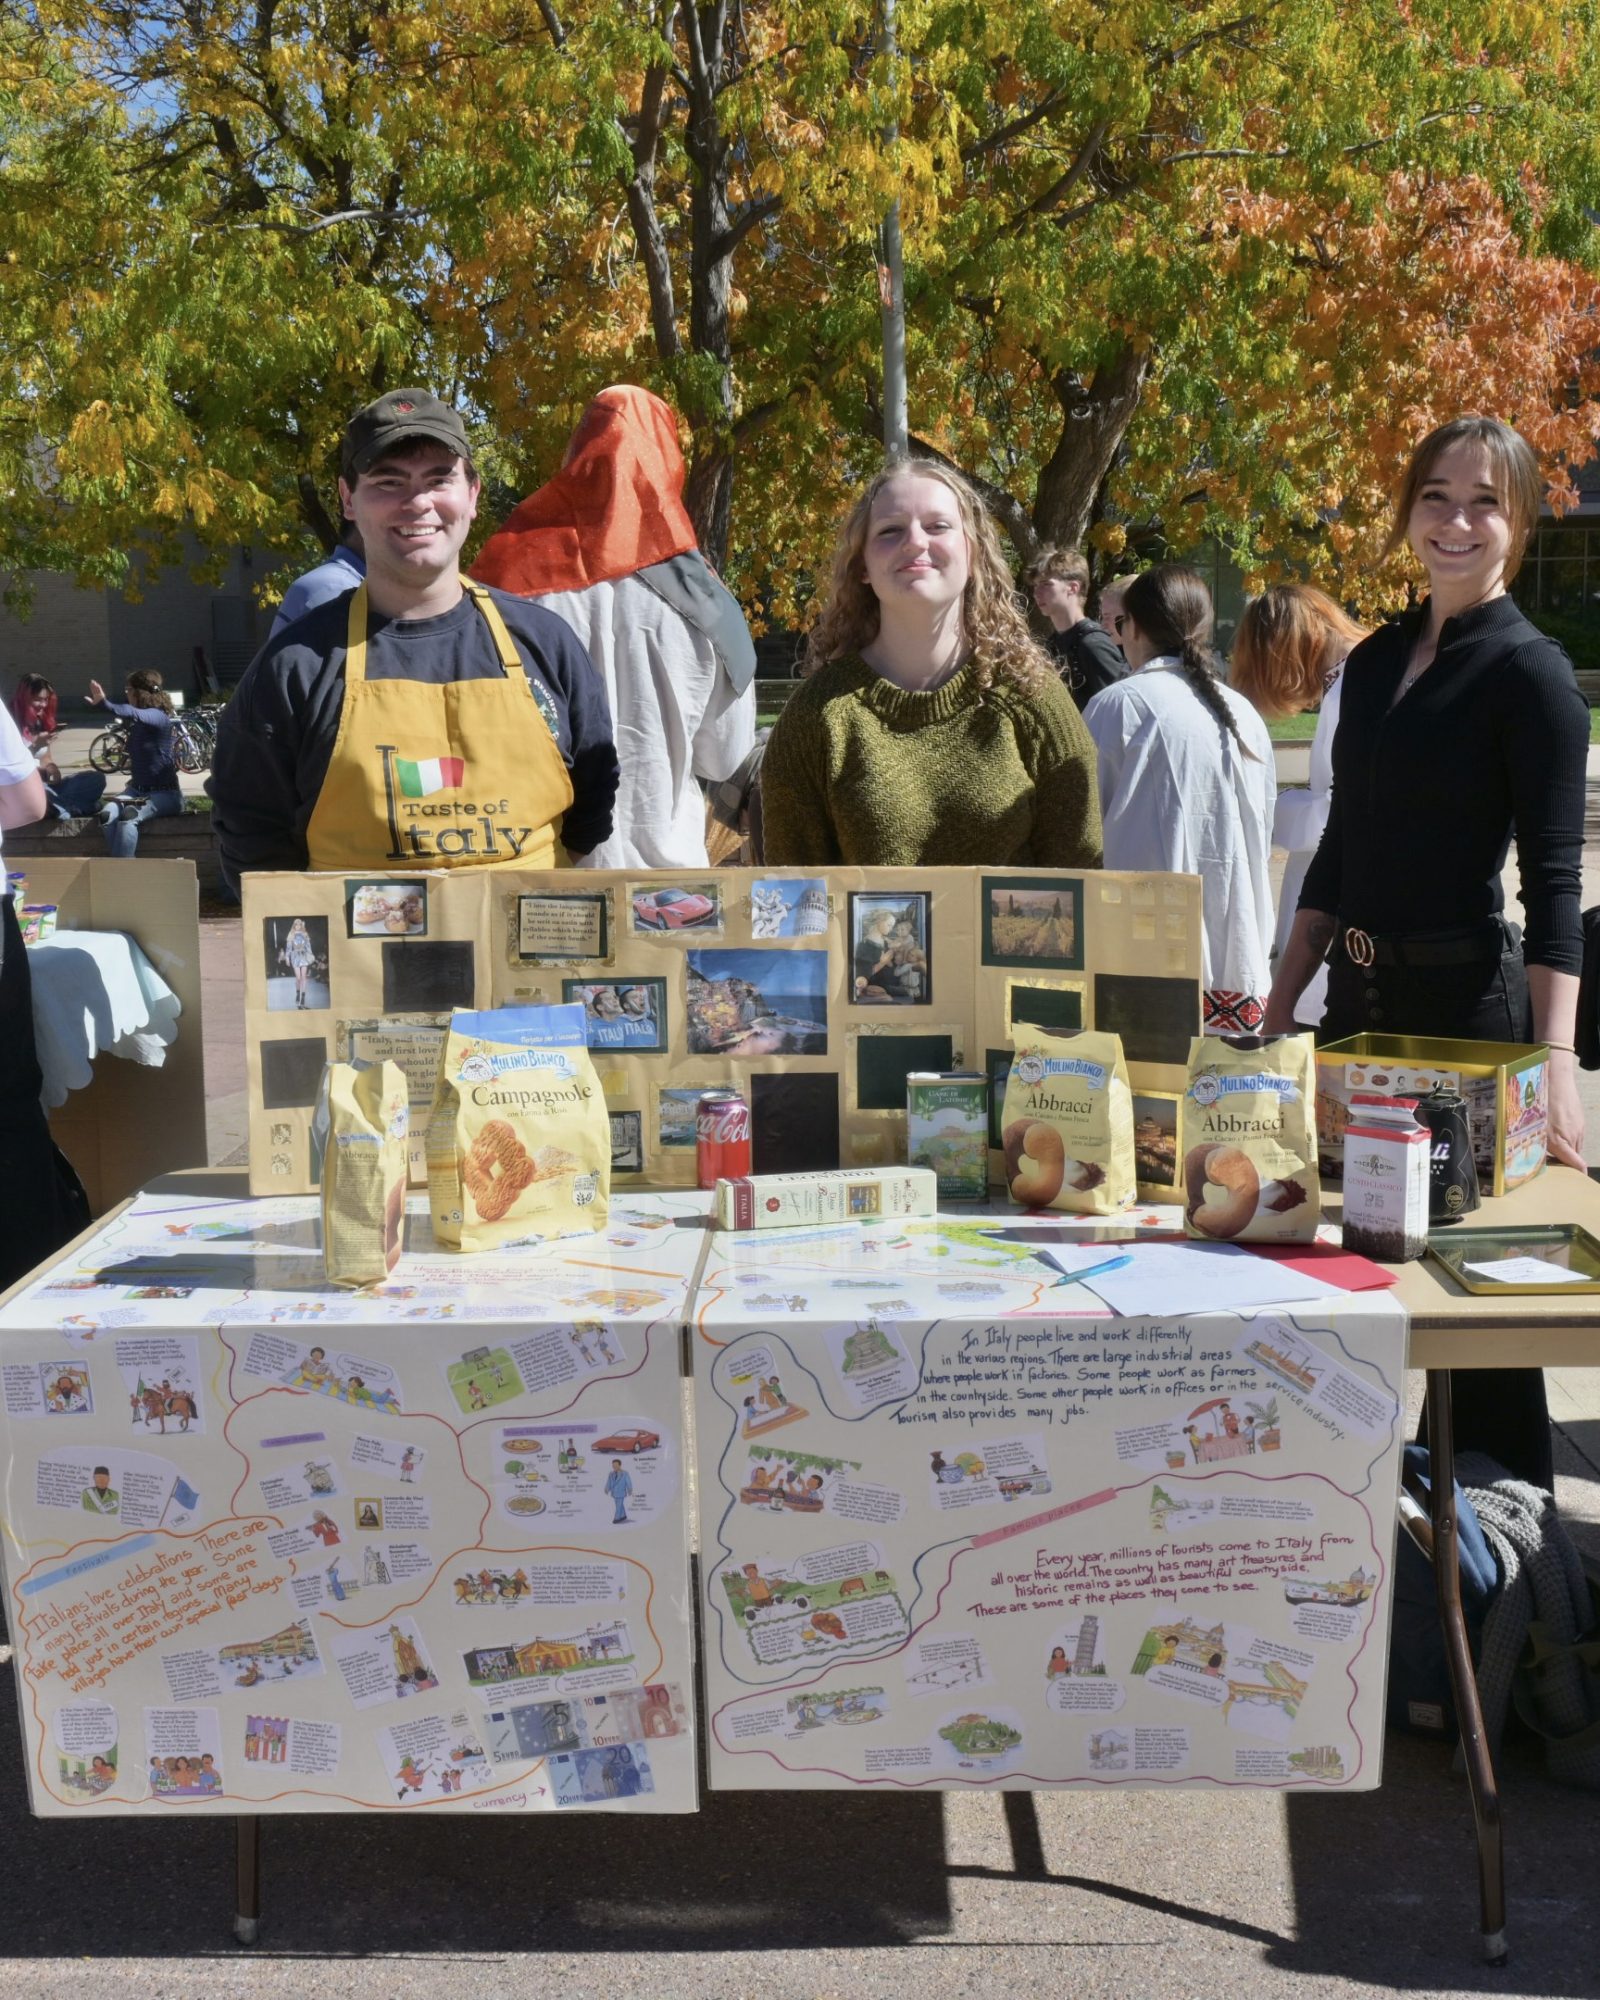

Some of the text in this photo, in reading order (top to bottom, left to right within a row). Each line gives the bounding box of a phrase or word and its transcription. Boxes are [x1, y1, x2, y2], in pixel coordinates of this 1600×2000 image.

[375, 744, 533, 862] Italy
[402, 799, 509, 817] Taste of
[375, 1047, 393, 1055] and
[418, 1046, 437, 1054] love
[472, 1084, 593, 1108] Campagnole
[1025, 1093, 1093, 1114] Abbracci
[1202, 1112, 1285, 1132] Abbracci
[962, 1325, 1192, 1352] In Italy people live and work differently
[942, 1346, 1232, 1370] in the various regions. There are large industrial areas
[923, 1364, 1256, 1386] where people work in factories. Some people work as farmers
[888, 1404, 1089, 1427] Tourism also provides many jobs.
[917, 1393, 926, 1403] in
[931, 1389, 947, 1402] the
[1017, 1387, 1047, 1399] Some
[1052, 1386, 1079, 1398] other
[1082, 1385, 1113, 1402] people
[1119, 1384, 1149, 1395] work
[1151, 1383, 1160, 1394] in
[1165, 1381, 1205, 1397] offices
[1228, 1380, 1237, 1390] in
[1240, 1379, 1257, 1390] the
[1265, 1381, 1304, 1406] service
[1303, 1404, 1346, 1440] industry.
[1036, 1549, 1073, 1570] Every
[1078, 1552, 1107, 1569] year,
[1110, 1546, 1152, 1560] millions
[1155, 1544, 1169, 1557] of
[1219, 1542, 1251, 1551] come
[1256, 1539, 1270, 1549] to
[1275, 1536, 1312, 1554] Italy
[1320, 1532, 1354, 1550] from
[26, 1602, 90, 1640] Italians
[85, 1589, 115, 1606] love
[193, 1531, 241, 1551] There
[242, 1520, 268, 1537] are
[990, 1550, 1324, 1586] all over the world. The country has many art treasures and
[1015, 1584, 1058, 1598] historic
[1064, 1580, 1110, 1592] remains
[1115, 1579, 1131, 1587] as
[1135, 1575, 1157, 1586] well
[1160, 1575, 1175, 1583] as
[1178, 1567, 1232, 1581] beautiful
[44, 1544, 256, 1652] many festivals during the year. Some
[967, 1583, 1258, 1617] These are some of the places they come to see.
[25, 1558, 258, 1680] take place all over Italy and some are
[83, 1647, 103, 1672] just
[107, 1643, 119, 1653] in
[122, 1619, 160, 1645] certain
[163, 1599, 206, 1622] regions.
[213, 1575, 251, 1599] Many
[71, 1667, 111, 1693] villages
[109, 1650, 135, 1667] have
[160, 1623, 183, 1638] own
[186, 1601, 222, 1625] special
[251, 1575, 286, 1594] days.
[584, 1696, 594, 1706] 10
[648, 1687, 670, 1707] 10
[553, 1703, 570, 1727] 5
[607, 1746, 633, 1765] 20
[472, 1792, 528, 1809] currency
